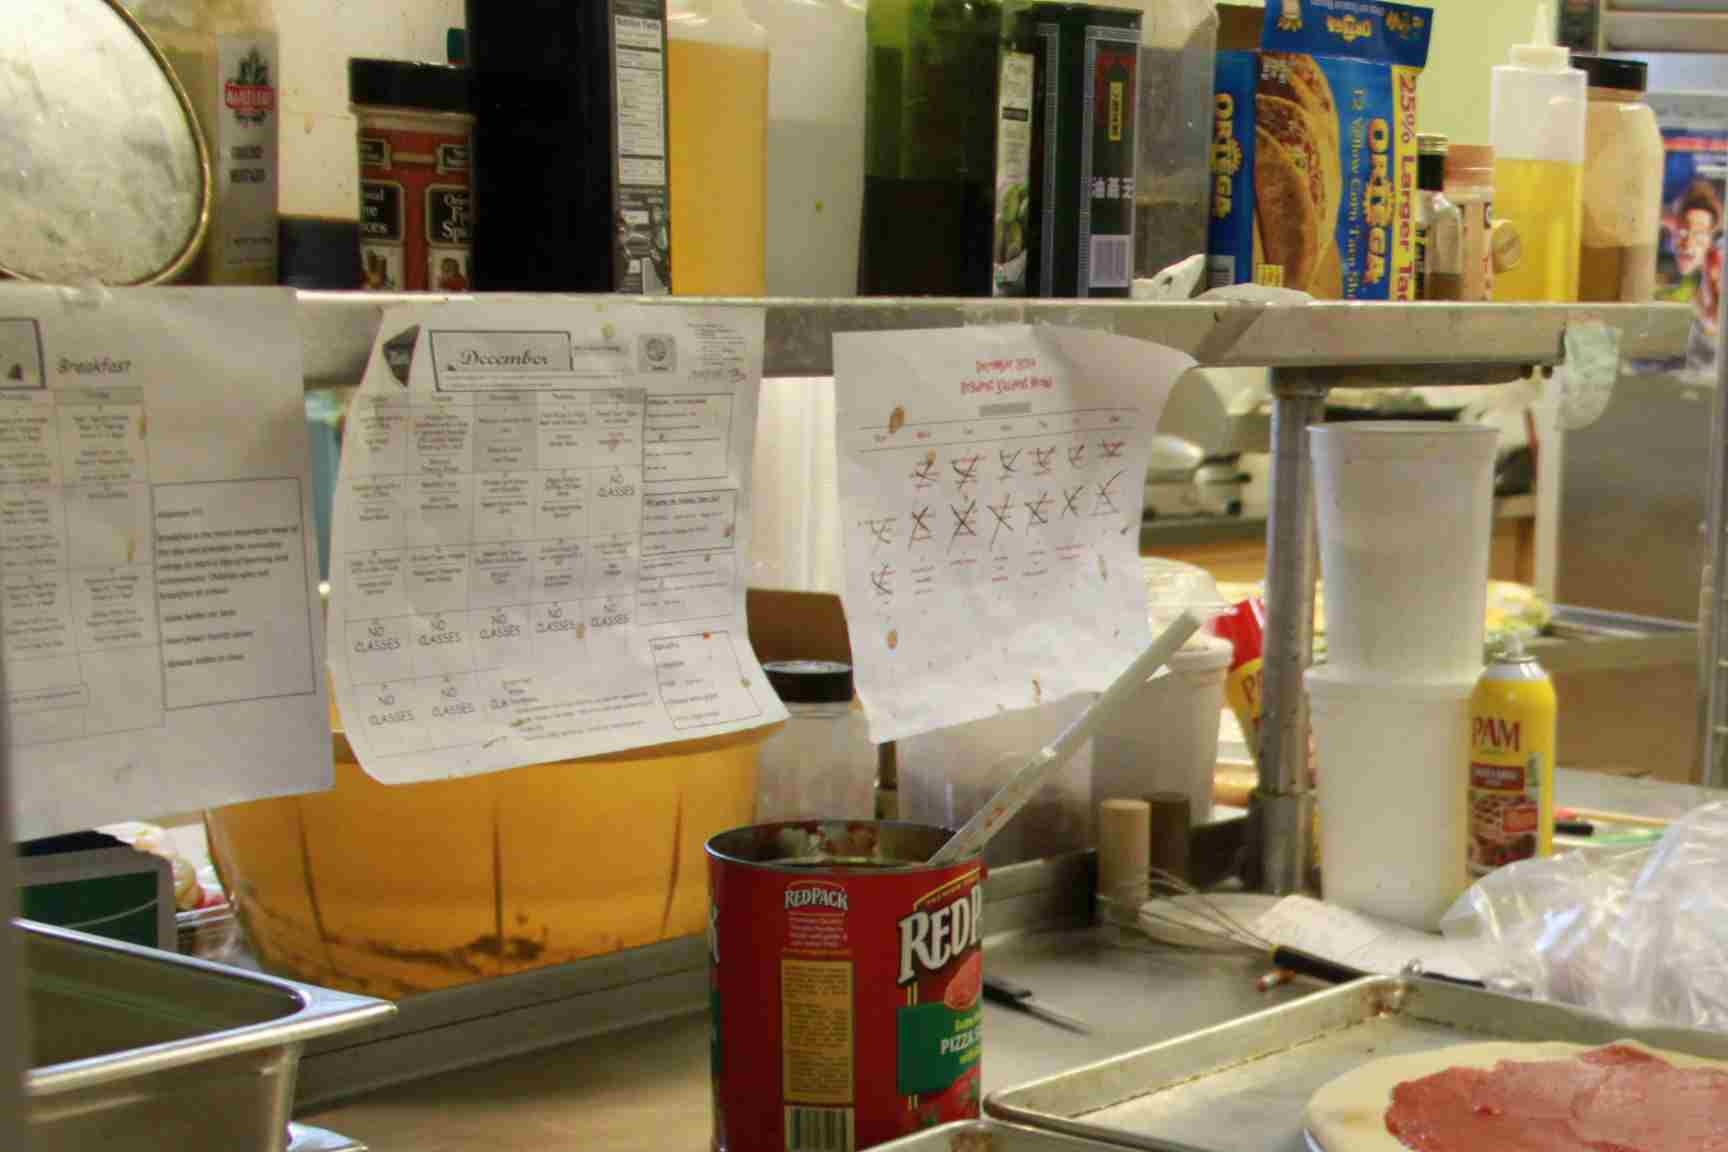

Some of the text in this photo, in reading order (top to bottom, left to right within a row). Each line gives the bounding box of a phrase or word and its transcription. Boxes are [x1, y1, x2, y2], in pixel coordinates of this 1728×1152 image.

[1351, 87, 1366, 111] 12
[1398, 75, 1416, 143] 25%
[1211, 91, 1243, 220] ORTEGA
[1350, 118, 1365, 175] Yellow
[1348, 177, 1362, 222] Corn
[1362, 117, 1396, 285] ORTEGA
[1396, 155, 1417, 250] Larger
[459, 347, 550, 367] December
[56, 357, 133, 376] Breakfast
[596, 486, 635, 498] CLASSES
[547, 606, 565, 619] NO
[603, 601, 619, 614] NO
[430, 617, 447, 631] NO
[490, 613, 508, 626] NO
[535, 619, 577, 634] CLASSES
[590, 613, 631, 628] CLASSES
[367, 625, 386, 637] NO
[417, 629, 462, 646] CLASSES
[478, 623, 521, 641] CLASSES
[353, 637, 401, 654] CLASSES
[378, 693, 397, 706] NO
[440, 686, 458, 699] NO
[368, 710, 414, 727] CLASSES
[431, 701, 475, 719] CLASSES
[1471, 716, 1522, 753] PAM
[783, 887, 850, 911] REDPACK
[896, 883, 983, 985] REDP
